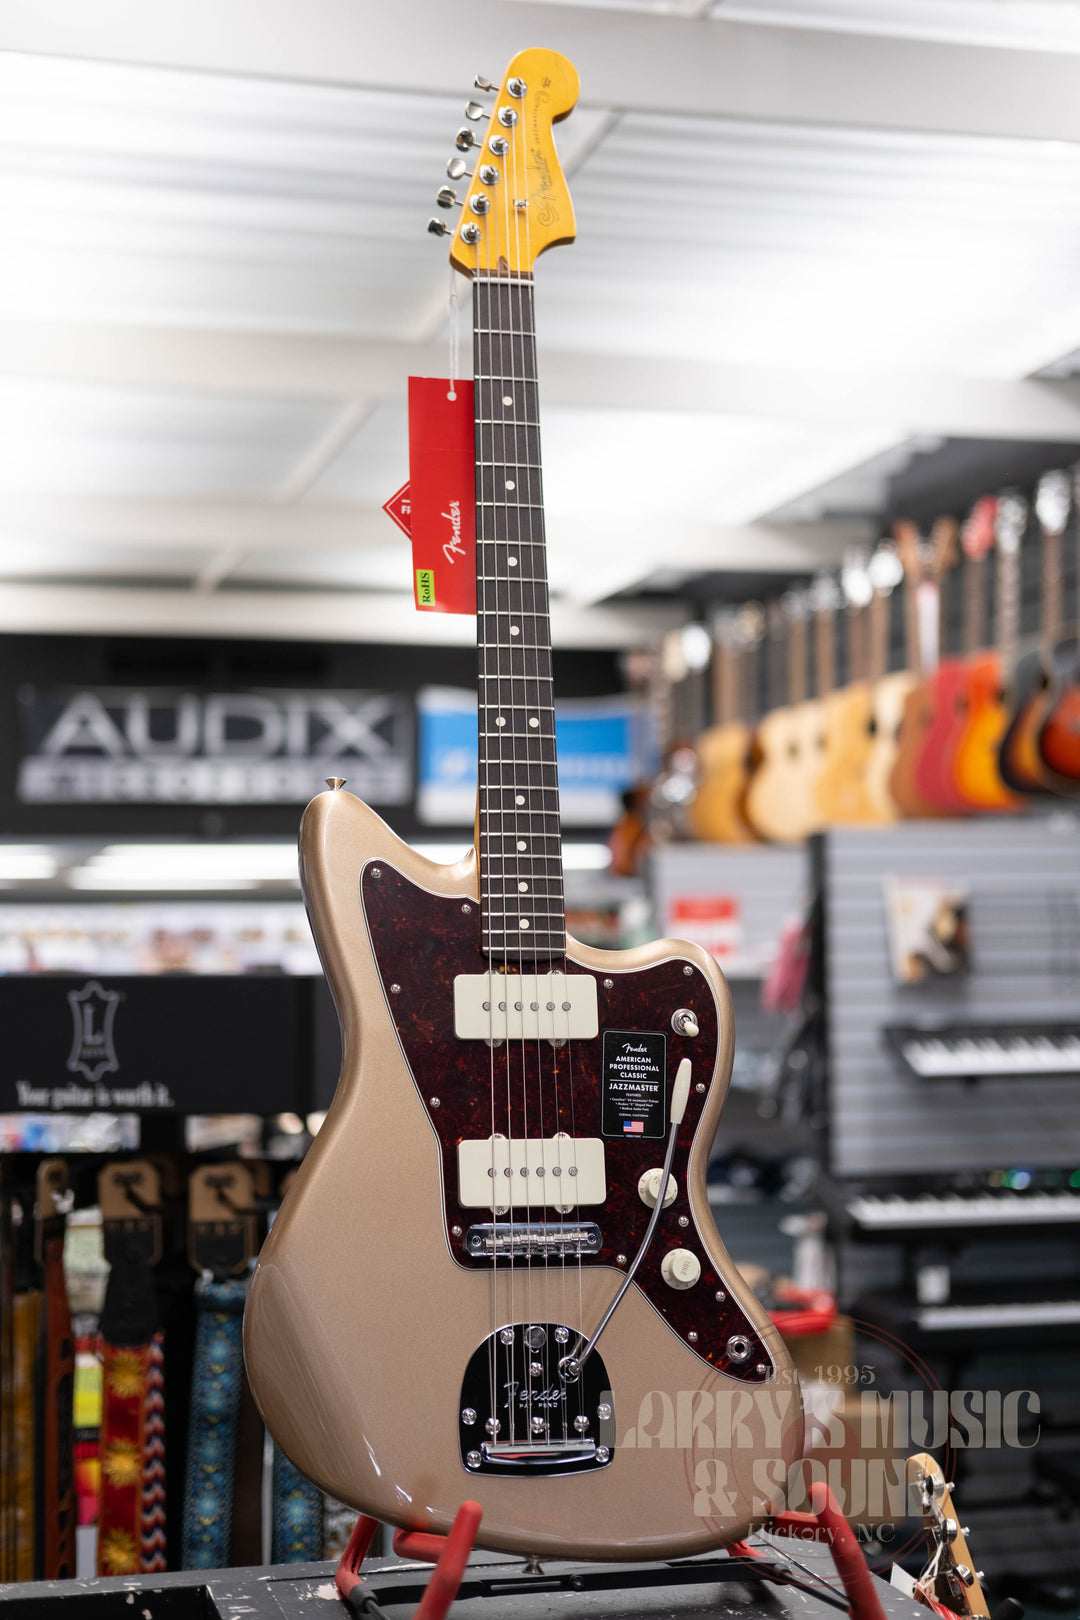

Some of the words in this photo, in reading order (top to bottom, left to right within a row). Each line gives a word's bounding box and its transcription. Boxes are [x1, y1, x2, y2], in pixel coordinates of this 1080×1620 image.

[441, 500, 466, 564] Fender
[422, 572, 431, 603] RoHS
[42, 692, 393, 763] AUDIX
[622, 1043, 647, 1053] Fender
[610, 1063, 659, 1071] PROFESSIONAL
[609, 1083, 659, 1092] JAZZMASTER
[504, 1381, 567, 1408] Fender
